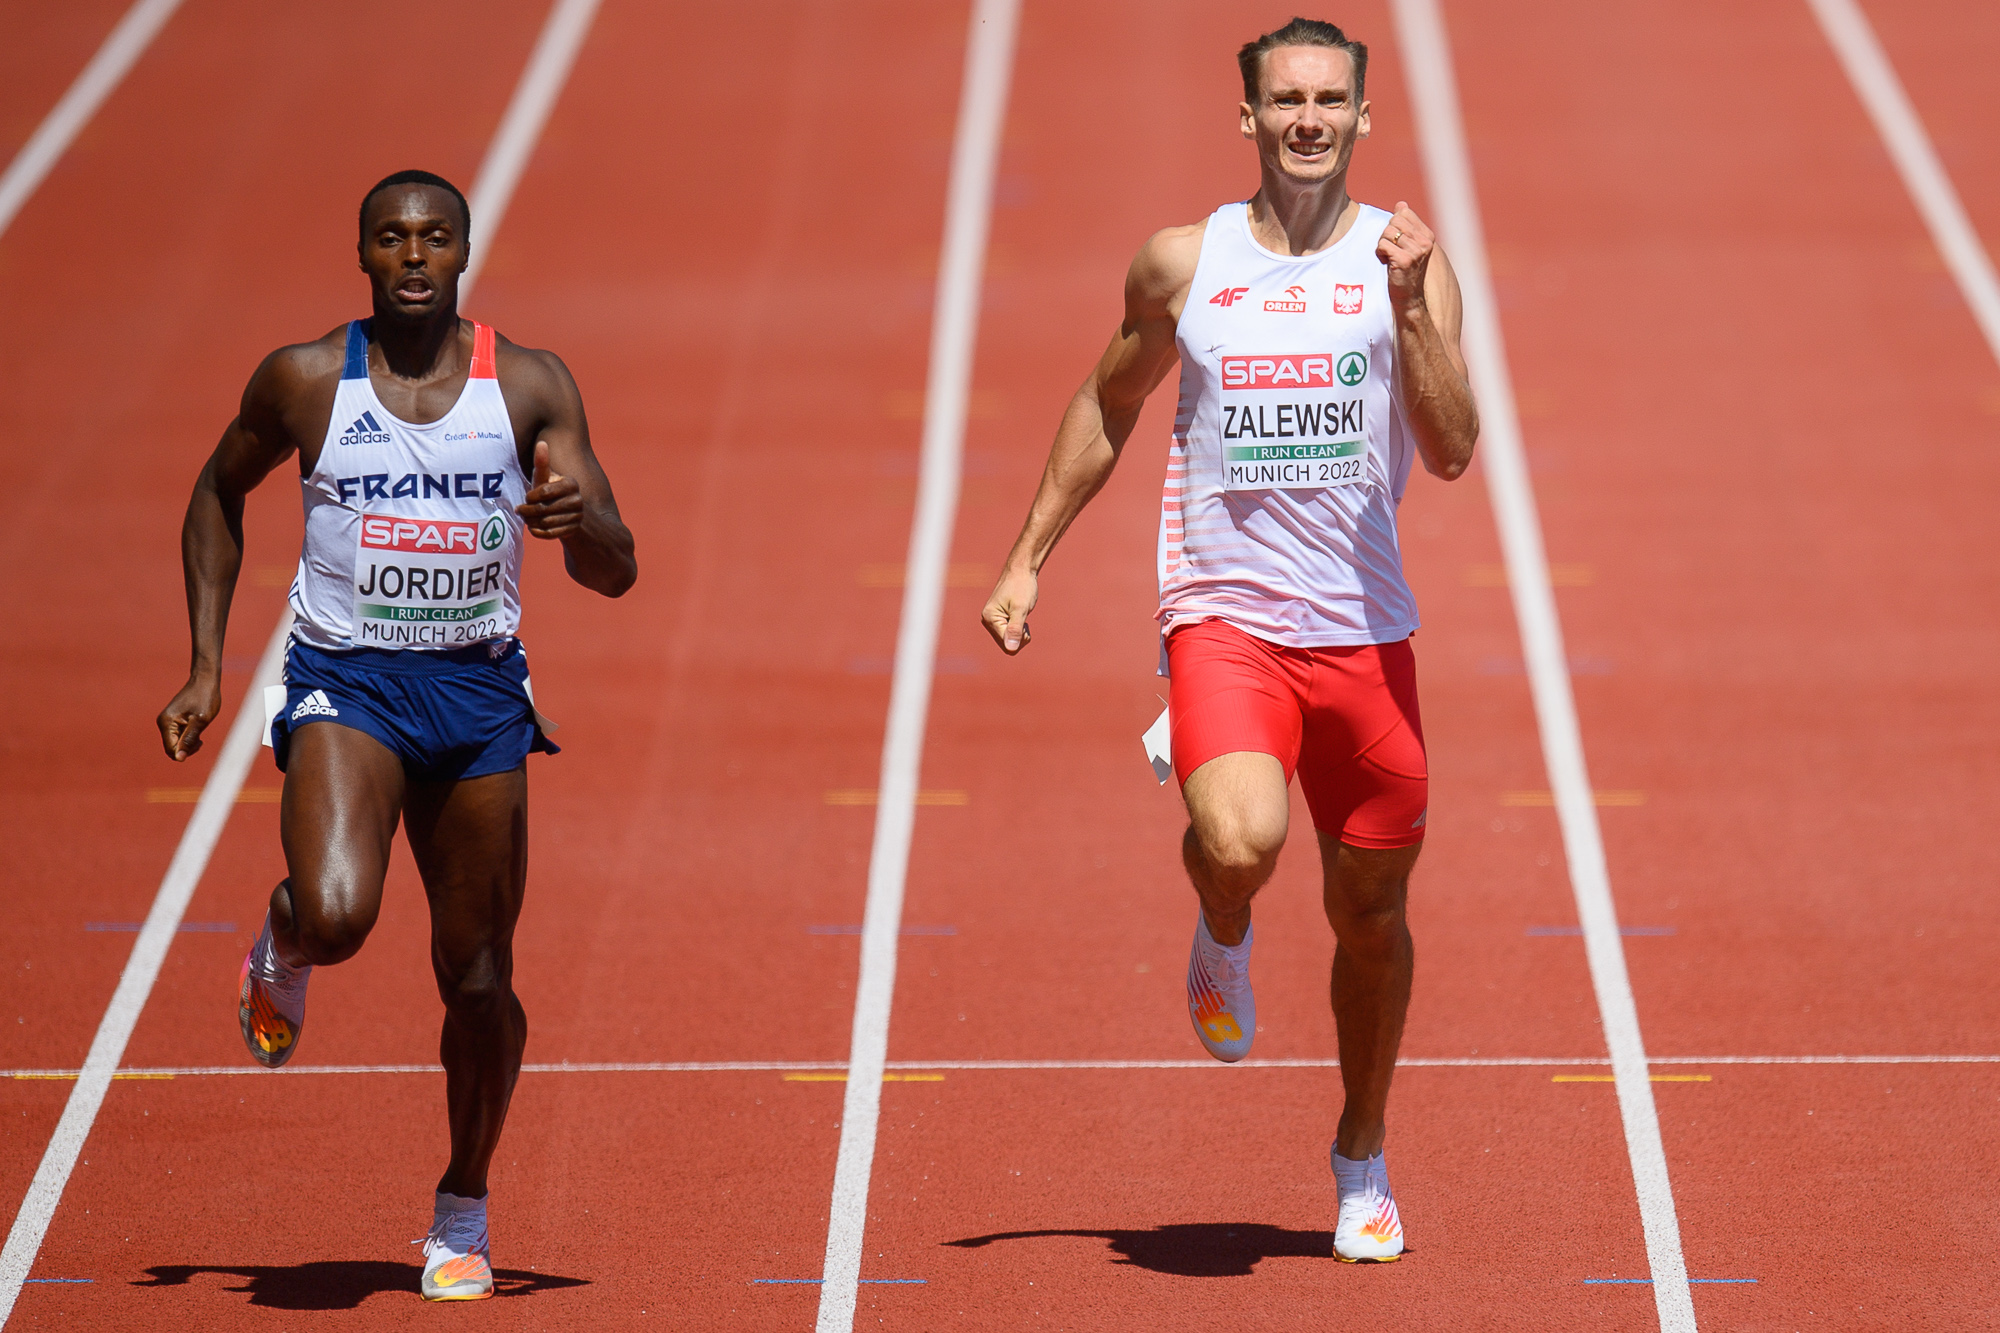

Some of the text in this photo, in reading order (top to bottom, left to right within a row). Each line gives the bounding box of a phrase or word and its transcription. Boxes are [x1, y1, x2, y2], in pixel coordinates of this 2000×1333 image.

[1209, 287, 1250, 307] 4F
[1265, 302, 1304, 312] ORLEN
[1224, 358, 1330, 385] SPAR
[1224, 399, 1363, 439] ZALEWSKI
[339, 432, 391, 446] adidas
[477, 432, 503, 440] Mutuel
[1253, 448, 1257, 459] I
[1261, 447, 1290, 458] RUN
[1230, 459, 1360, 484] MUNICH 2022
[336, 471, 504, 503] FRANCE
[364, 519, 476, 551] SPAR
[358, 561, 501, 600] JORDIER
[390, 608, 395, 619] I
[398, 608, 428, 620] RUN
[362, 618, 498, 643] MUNICH 2022
[291, 704, 339, 721] adidas
